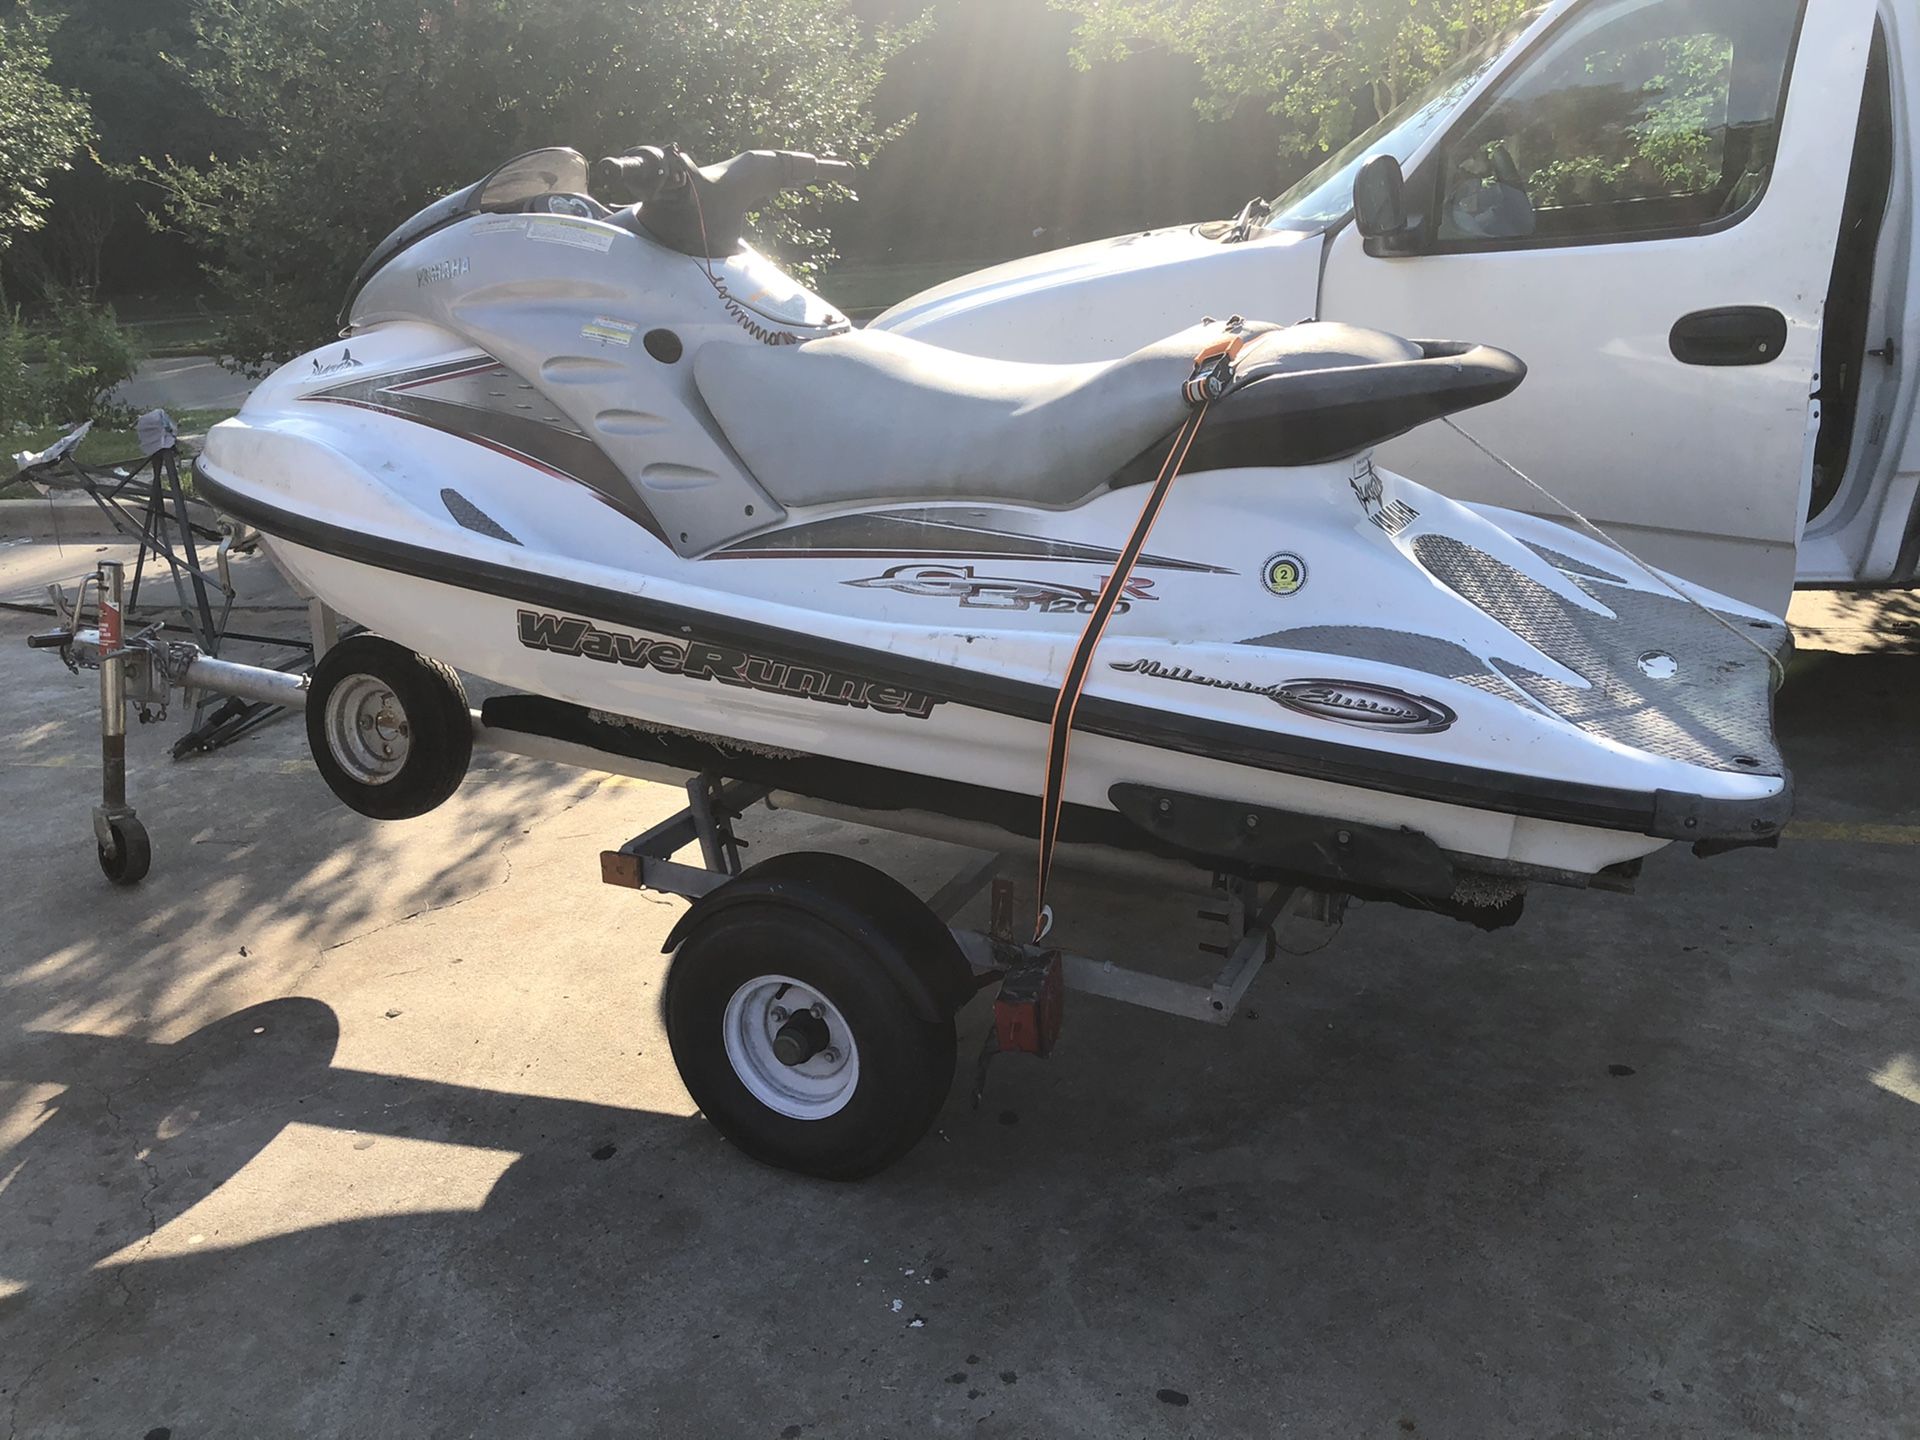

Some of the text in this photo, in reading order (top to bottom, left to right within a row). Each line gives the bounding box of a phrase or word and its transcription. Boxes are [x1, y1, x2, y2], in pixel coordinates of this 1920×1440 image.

[1368, 498, 1421, 537] YAMAHA
[1280, 569, 1288, 580] 2
[517, 609, 944, 720] WaveRunner
[1108, 658, 1420, 721] Millennium Edition
